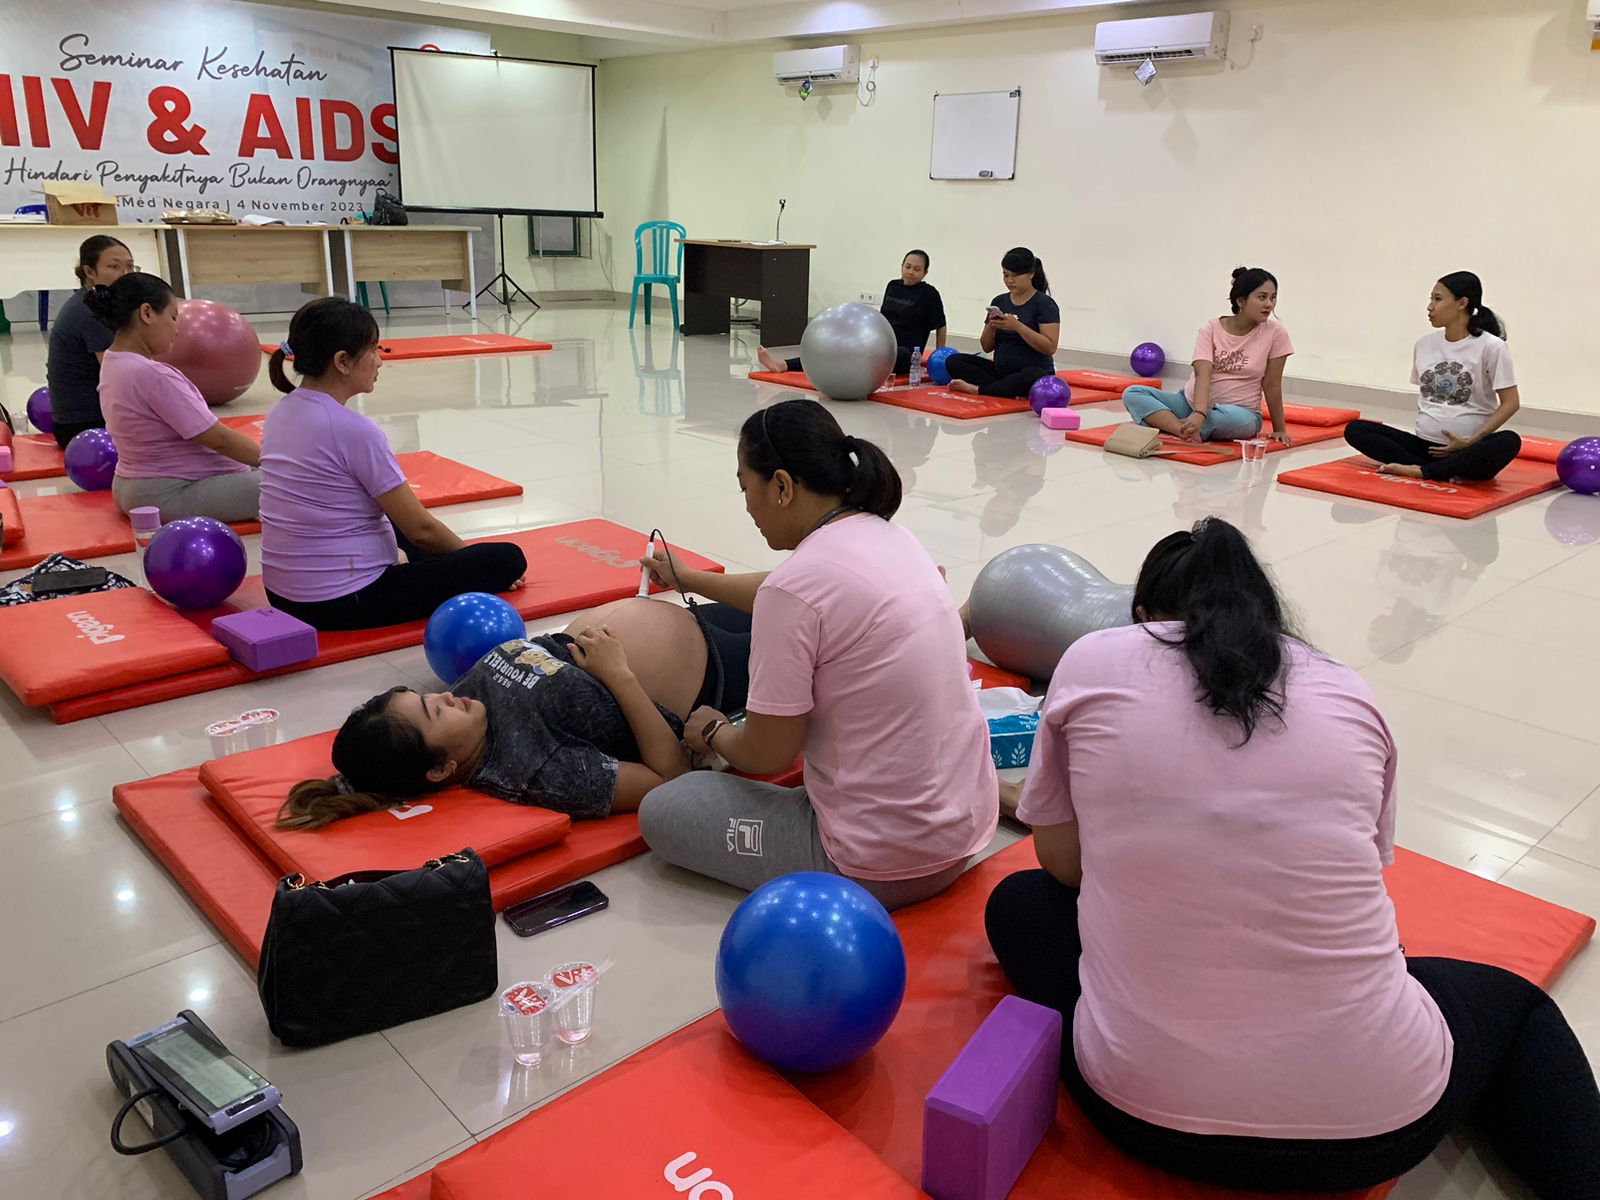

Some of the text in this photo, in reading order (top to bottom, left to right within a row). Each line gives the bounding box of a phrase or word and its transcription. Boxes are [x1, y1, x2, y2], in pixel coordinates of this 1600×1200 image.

[59, 33, 184, 72] Seminar
[197, 46, 328, 86] Kesehatan
[147, 86, 210, 156] &
[238, 93, 398, 165] AIDS
[4, 157, 92, 186] Hindari
[96, 160, 224, 194] Penyakitnya
[228, 163, 293, 188] Bukan
[163, 199, 220, 211] Negara
[237, 201, 246, 210] 4
[251, 200, 326, 212] November
[330, 202, 363, 212] 2023
[1219, 349, 1245, 358] PINK
[483, 650, 541, 690] BE YOURSELF
[493, 673, 513, 689] BEAR
[727, 818, 735, 852] FILA
